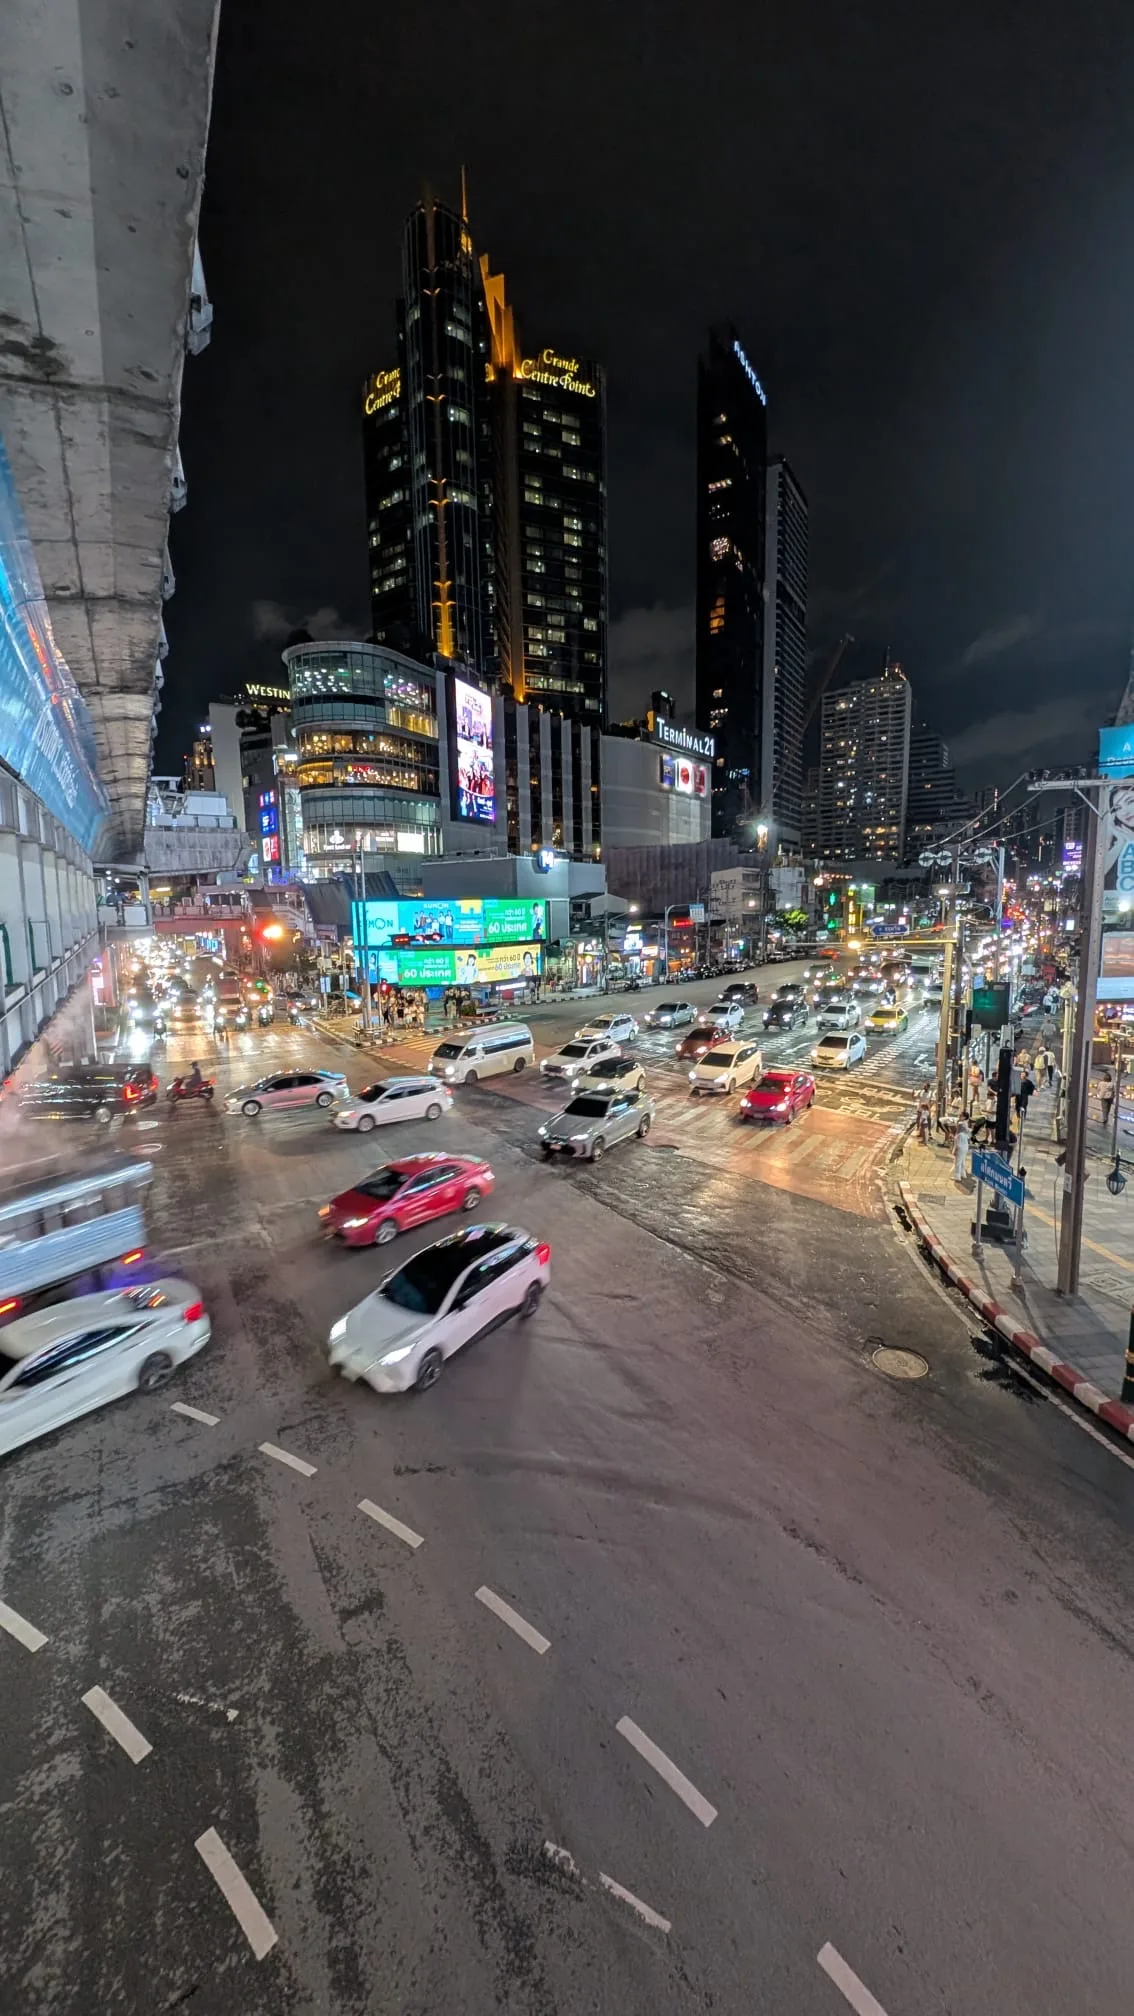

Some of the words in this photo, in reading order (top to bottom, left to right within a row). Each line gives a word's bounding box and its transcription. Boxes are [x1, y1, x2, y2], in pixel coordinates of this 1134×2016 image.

[543, 348, 580, 373] Grande
[521, 359, 559, 387] Centre
[559, 372, 596, 397] Point
[245, 683, 291, 700] WESTIN
[488, 921, 500, 934] 60
[404, 968, 417, 978] 60
